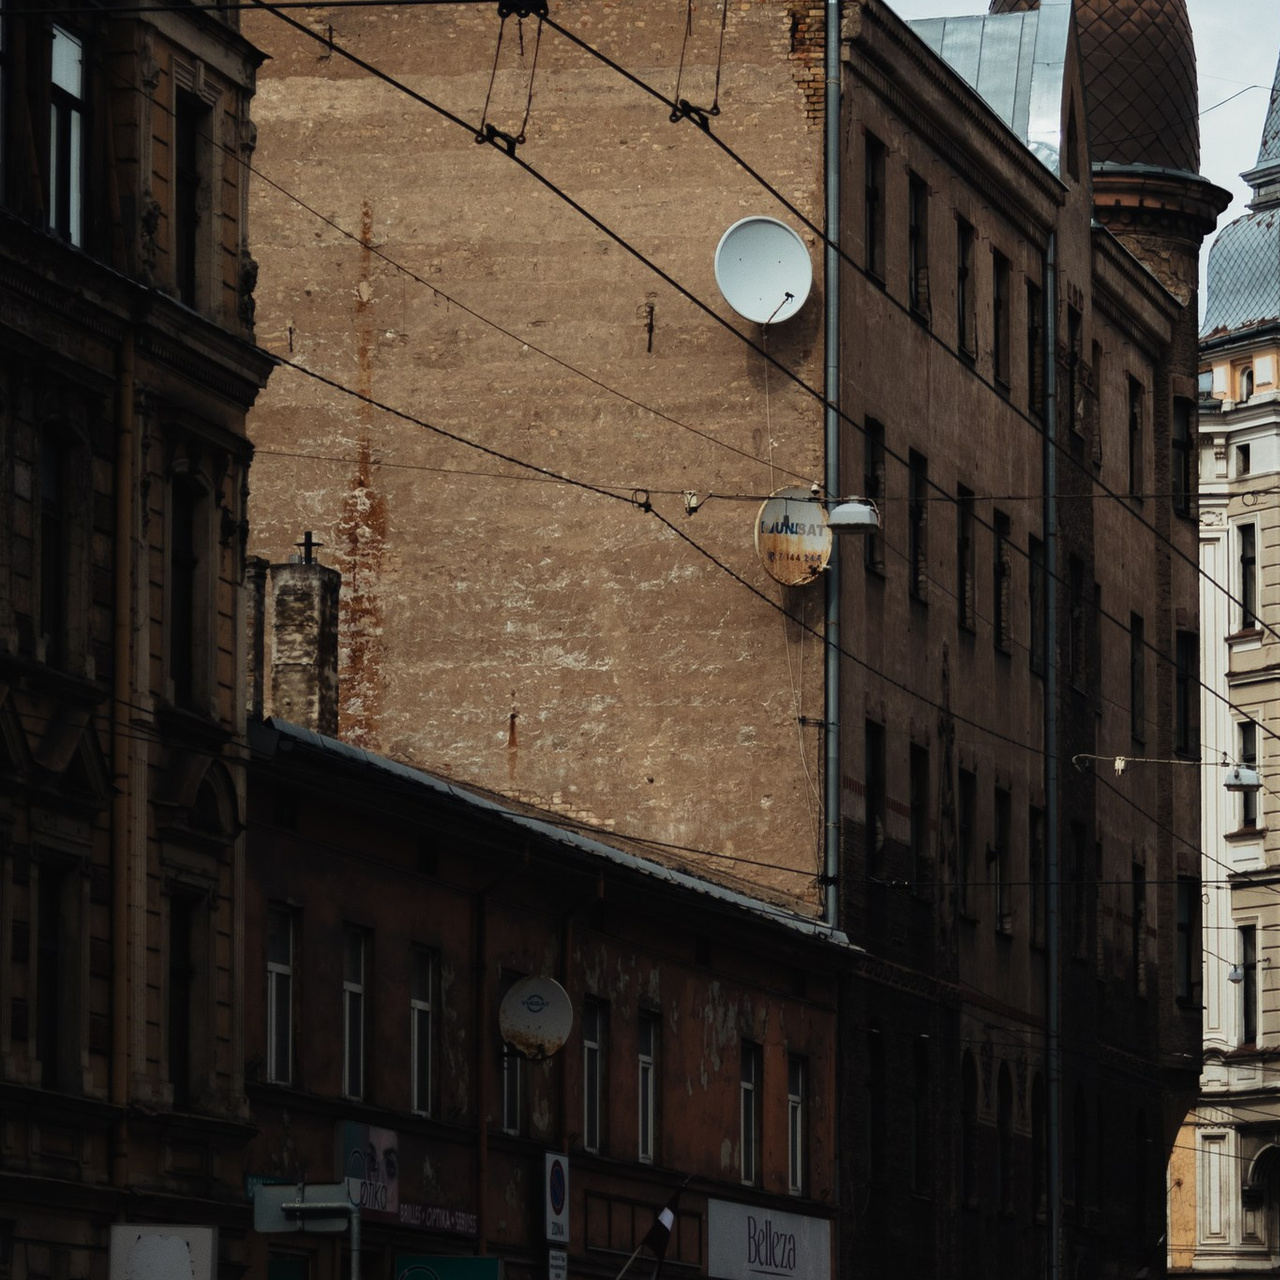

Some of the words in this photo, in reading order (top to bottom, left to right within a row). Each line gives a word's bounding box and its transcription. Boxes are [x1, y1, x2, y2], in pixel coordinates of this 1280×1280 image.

[425, 1207, 451, 1229] OPTIKA
[551, 1222, 564, 1237] ZONA
[747, 1216, 796, 1270] Belleza
